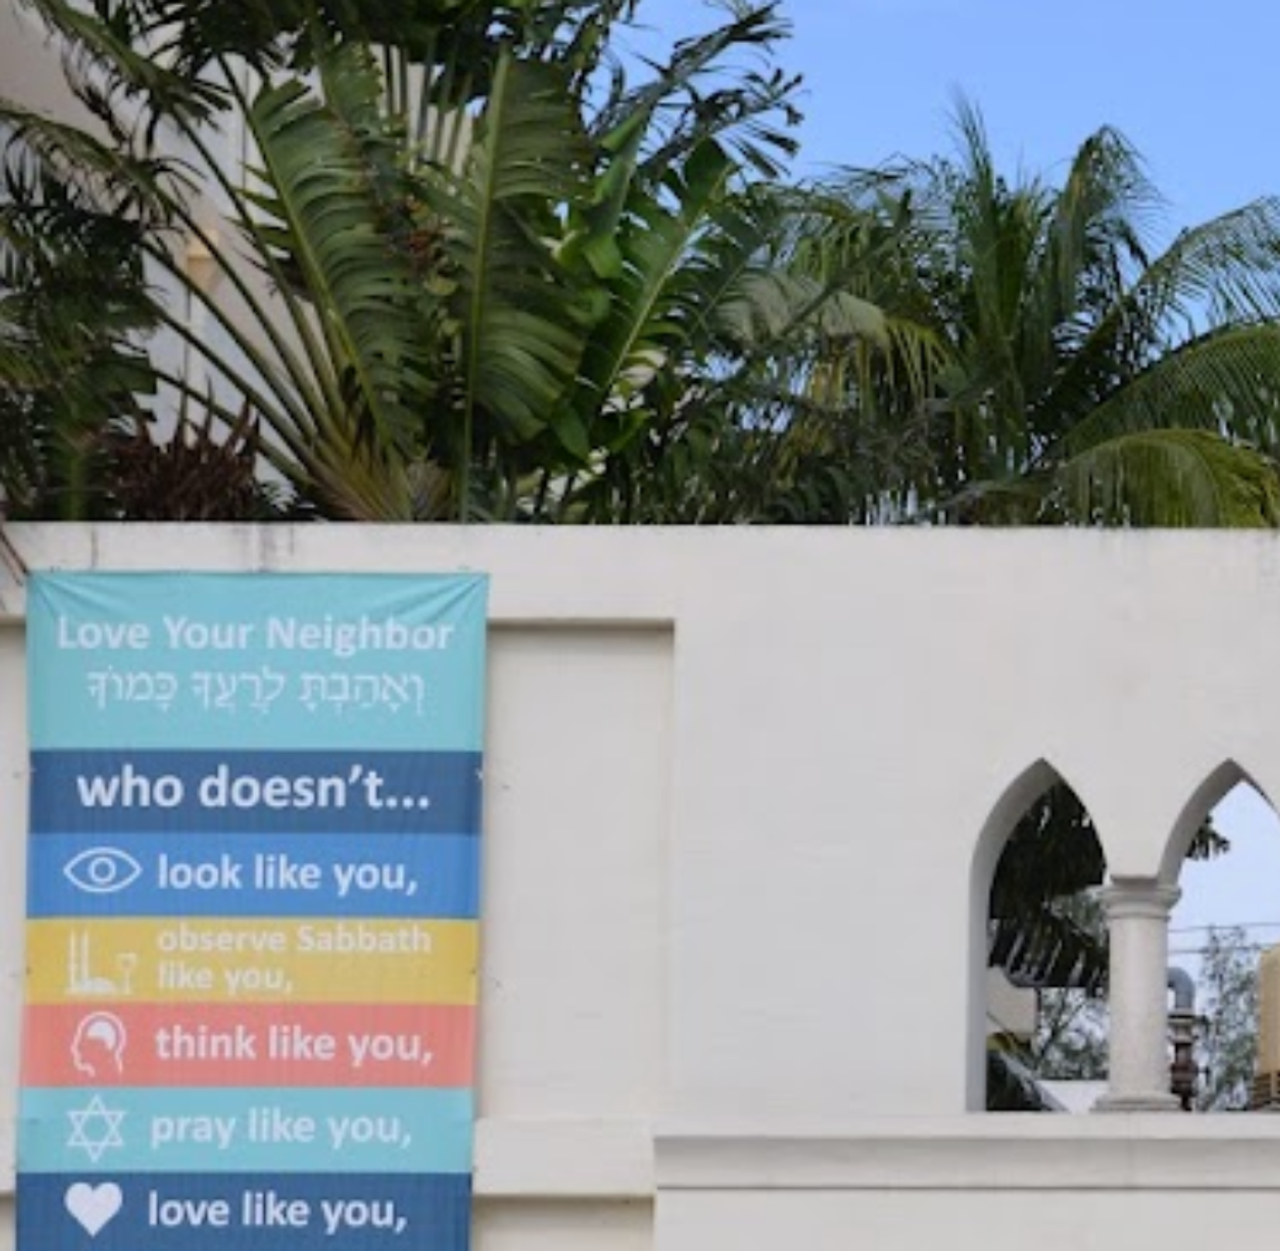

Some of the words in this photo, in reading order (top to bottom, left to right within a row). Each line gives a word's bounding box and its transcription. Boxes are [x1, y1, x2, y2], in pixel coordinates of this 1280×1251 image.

[57, 617, 149, 649] Love
[164, 617, 253, 649] Your
[267, 616, 454, 657] Neighbor
[77, 764, 183, 806] who
[158, 854, 241, 889] look
[256, 854, 321, 889] like
[334, 864, 417, 896] you,
[157, 925, 286, 954] observe
[297, 924, 432, 954] Sabbath
[158, 963, 217, 990] like
[224, 970, 293, 995] you,
[156, 1025, 255, 1059] think
[270, 1025, 335, 1059] like
[348, 1035, 432, 1066] you,
[152, 1116, 236, 1149] pray
[249, 1107, 315, 1142] like
[328, 1117, 411, 1149] you,
[149, 1191, 229, 1226] love
[243, 1191, 309, 1226] like
[322, 1201, 406, 1234] you,
